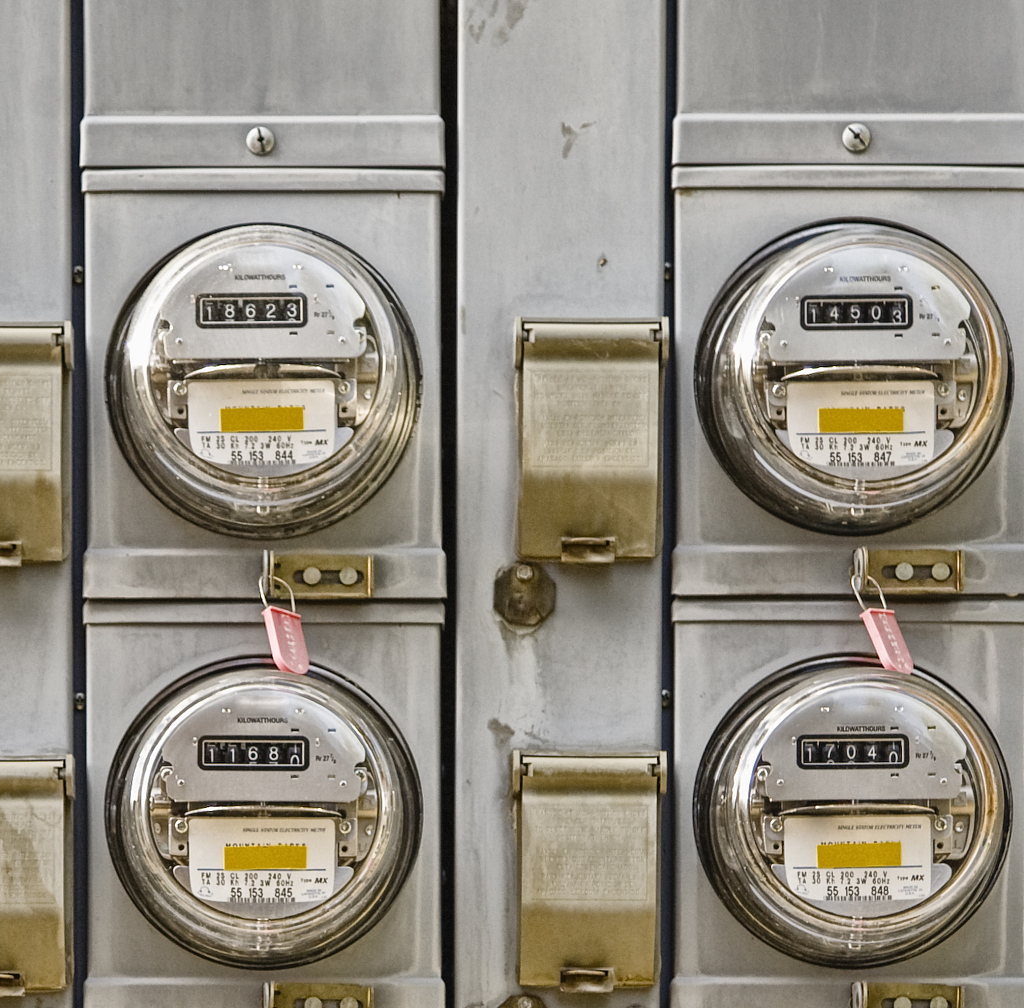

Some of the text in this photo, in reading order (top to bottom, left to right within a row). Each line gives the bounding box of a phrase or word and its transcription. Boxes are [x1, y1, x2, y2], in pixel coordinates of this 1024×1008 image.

[207, 302, 297, 320] 18623
[231, 451, 293, 461] 55 153 844
[830, 452, 892, 462] 55 153 847
[231, 888, 242, 897] 55
[249, 888, 263, 897] 153
[275, 888, 292, 897] 845
[827, 886, 838, 896] 55
[845, 886, 859, 896] 153
[871, 886, 889, 896] 848
